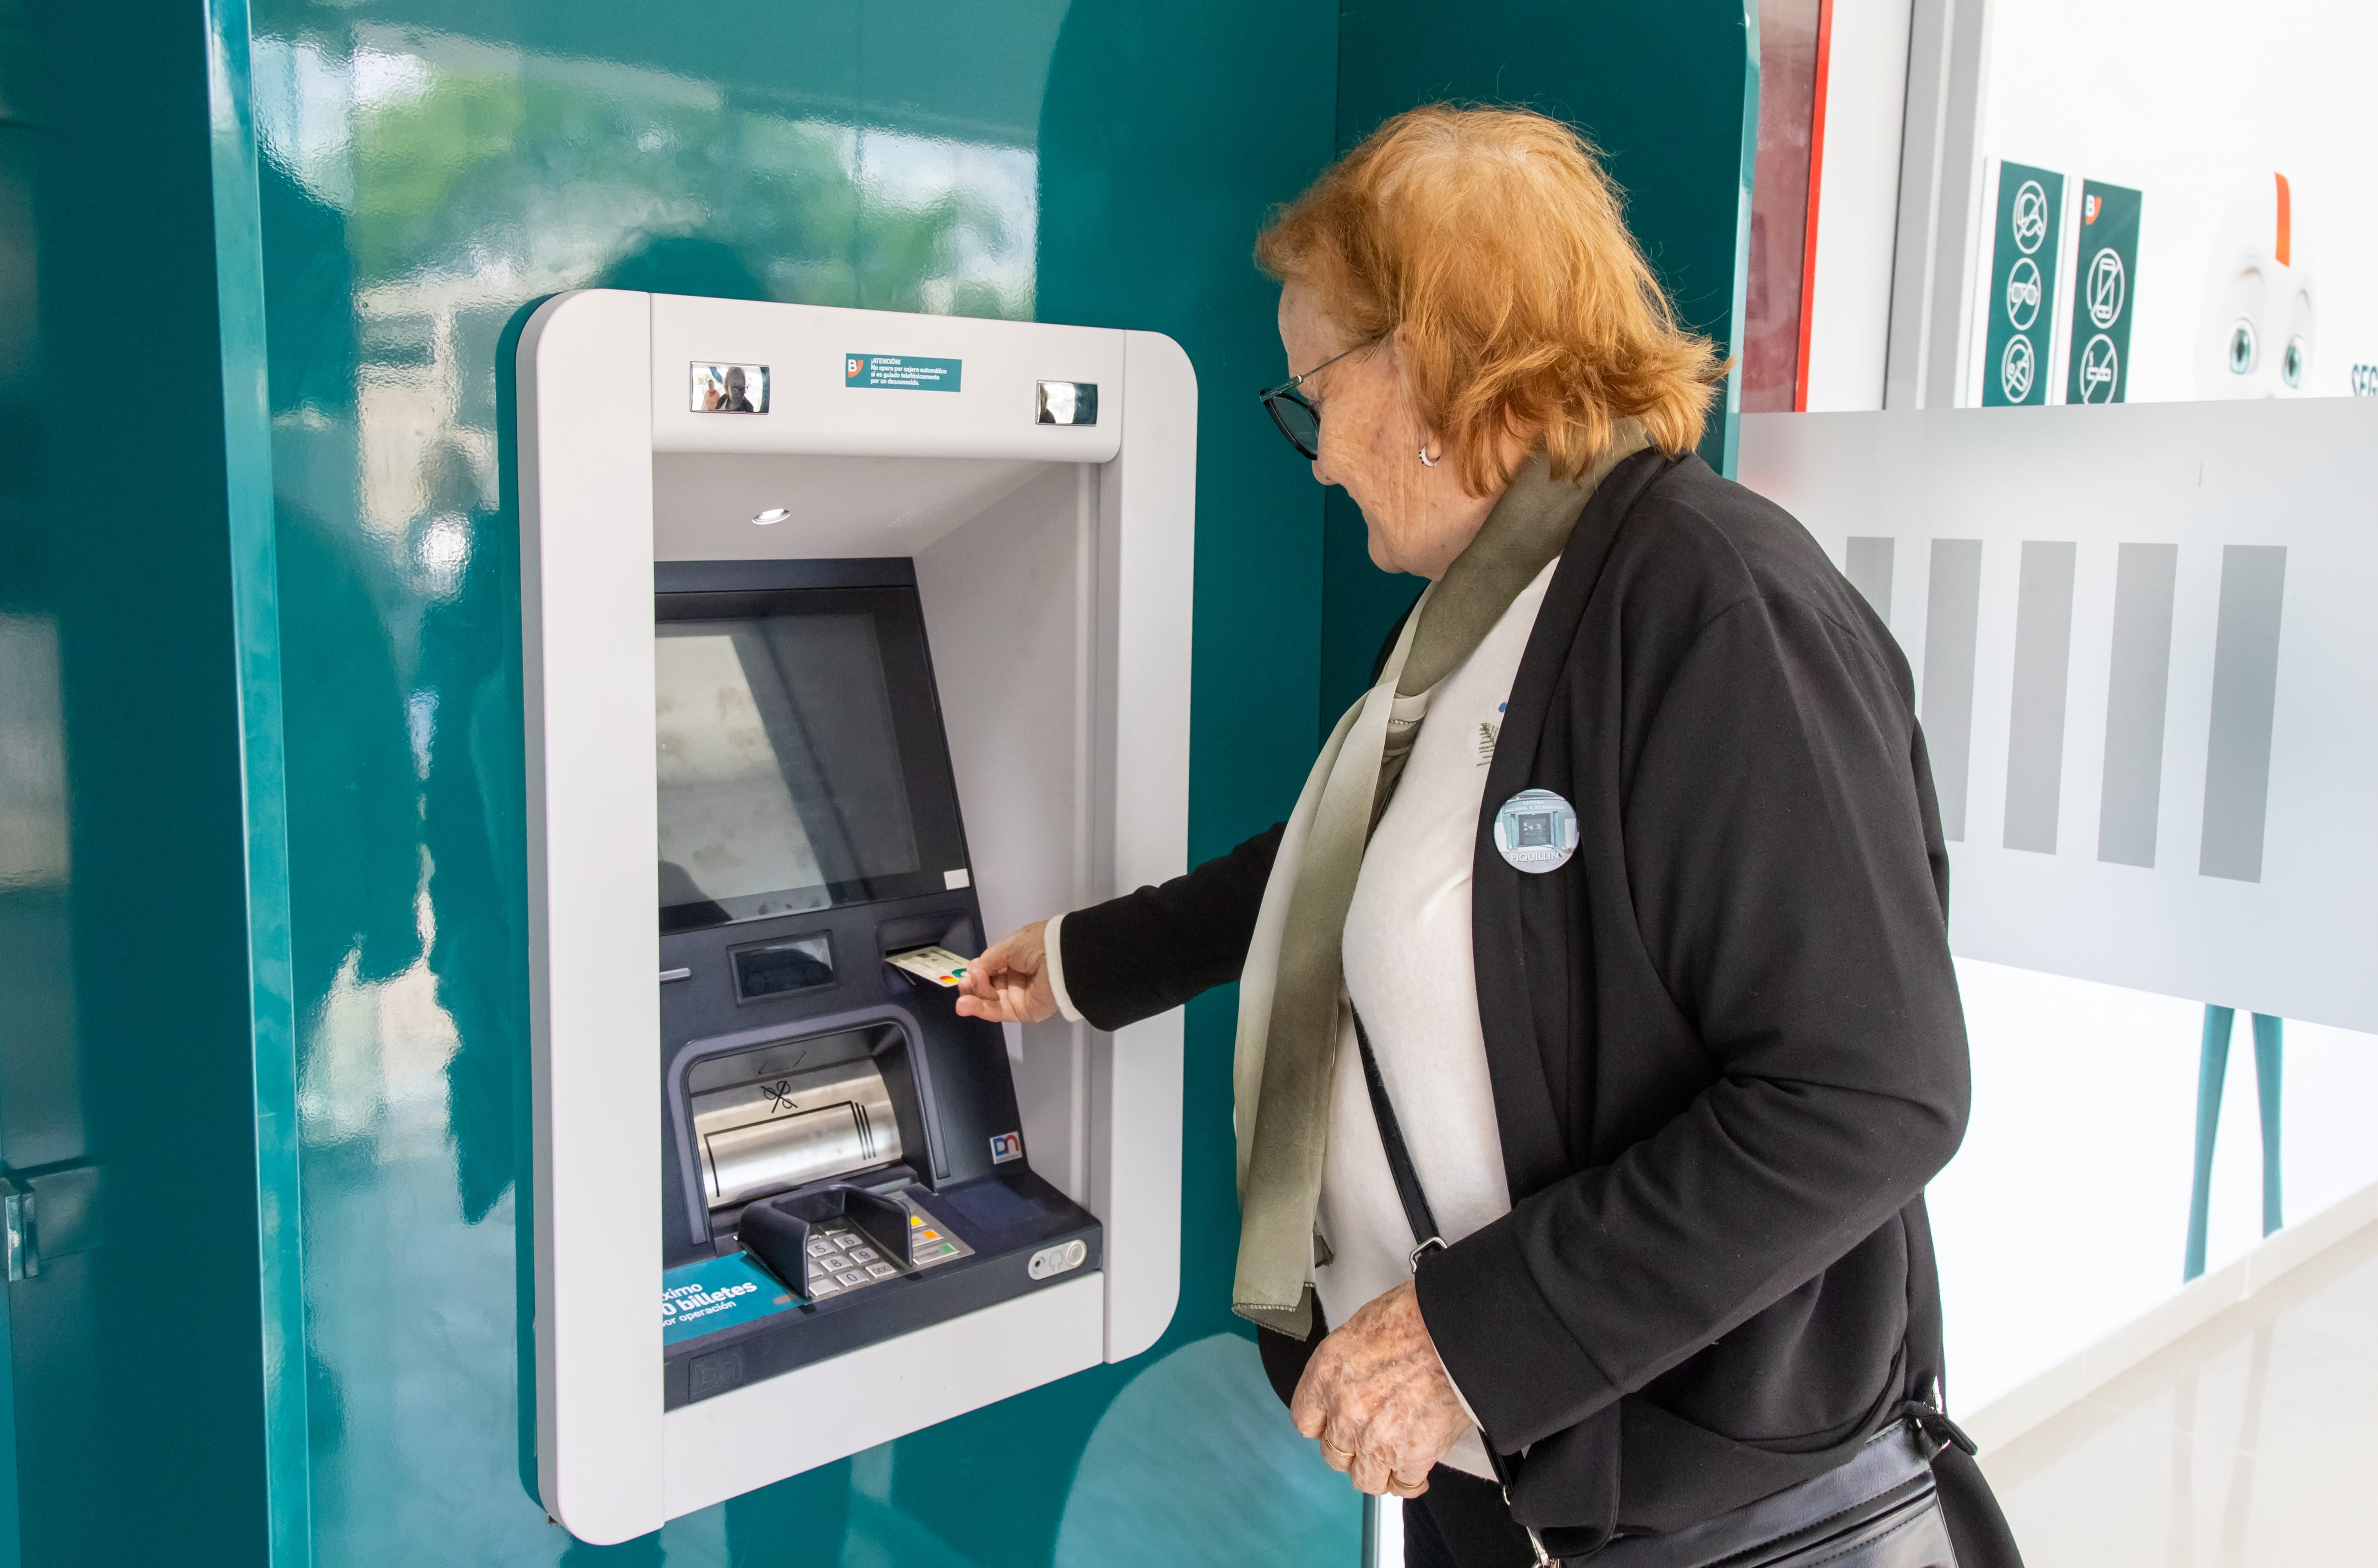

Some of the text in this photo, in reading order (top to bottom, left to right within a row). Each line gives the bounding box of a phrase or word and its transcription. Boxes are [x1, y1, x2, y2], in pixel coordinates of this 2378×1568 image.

[663, 1284, 703, 1301] ximo
[675, 1282, 757, 1311] billetes
[679, 1301, 737, 1321] operación
